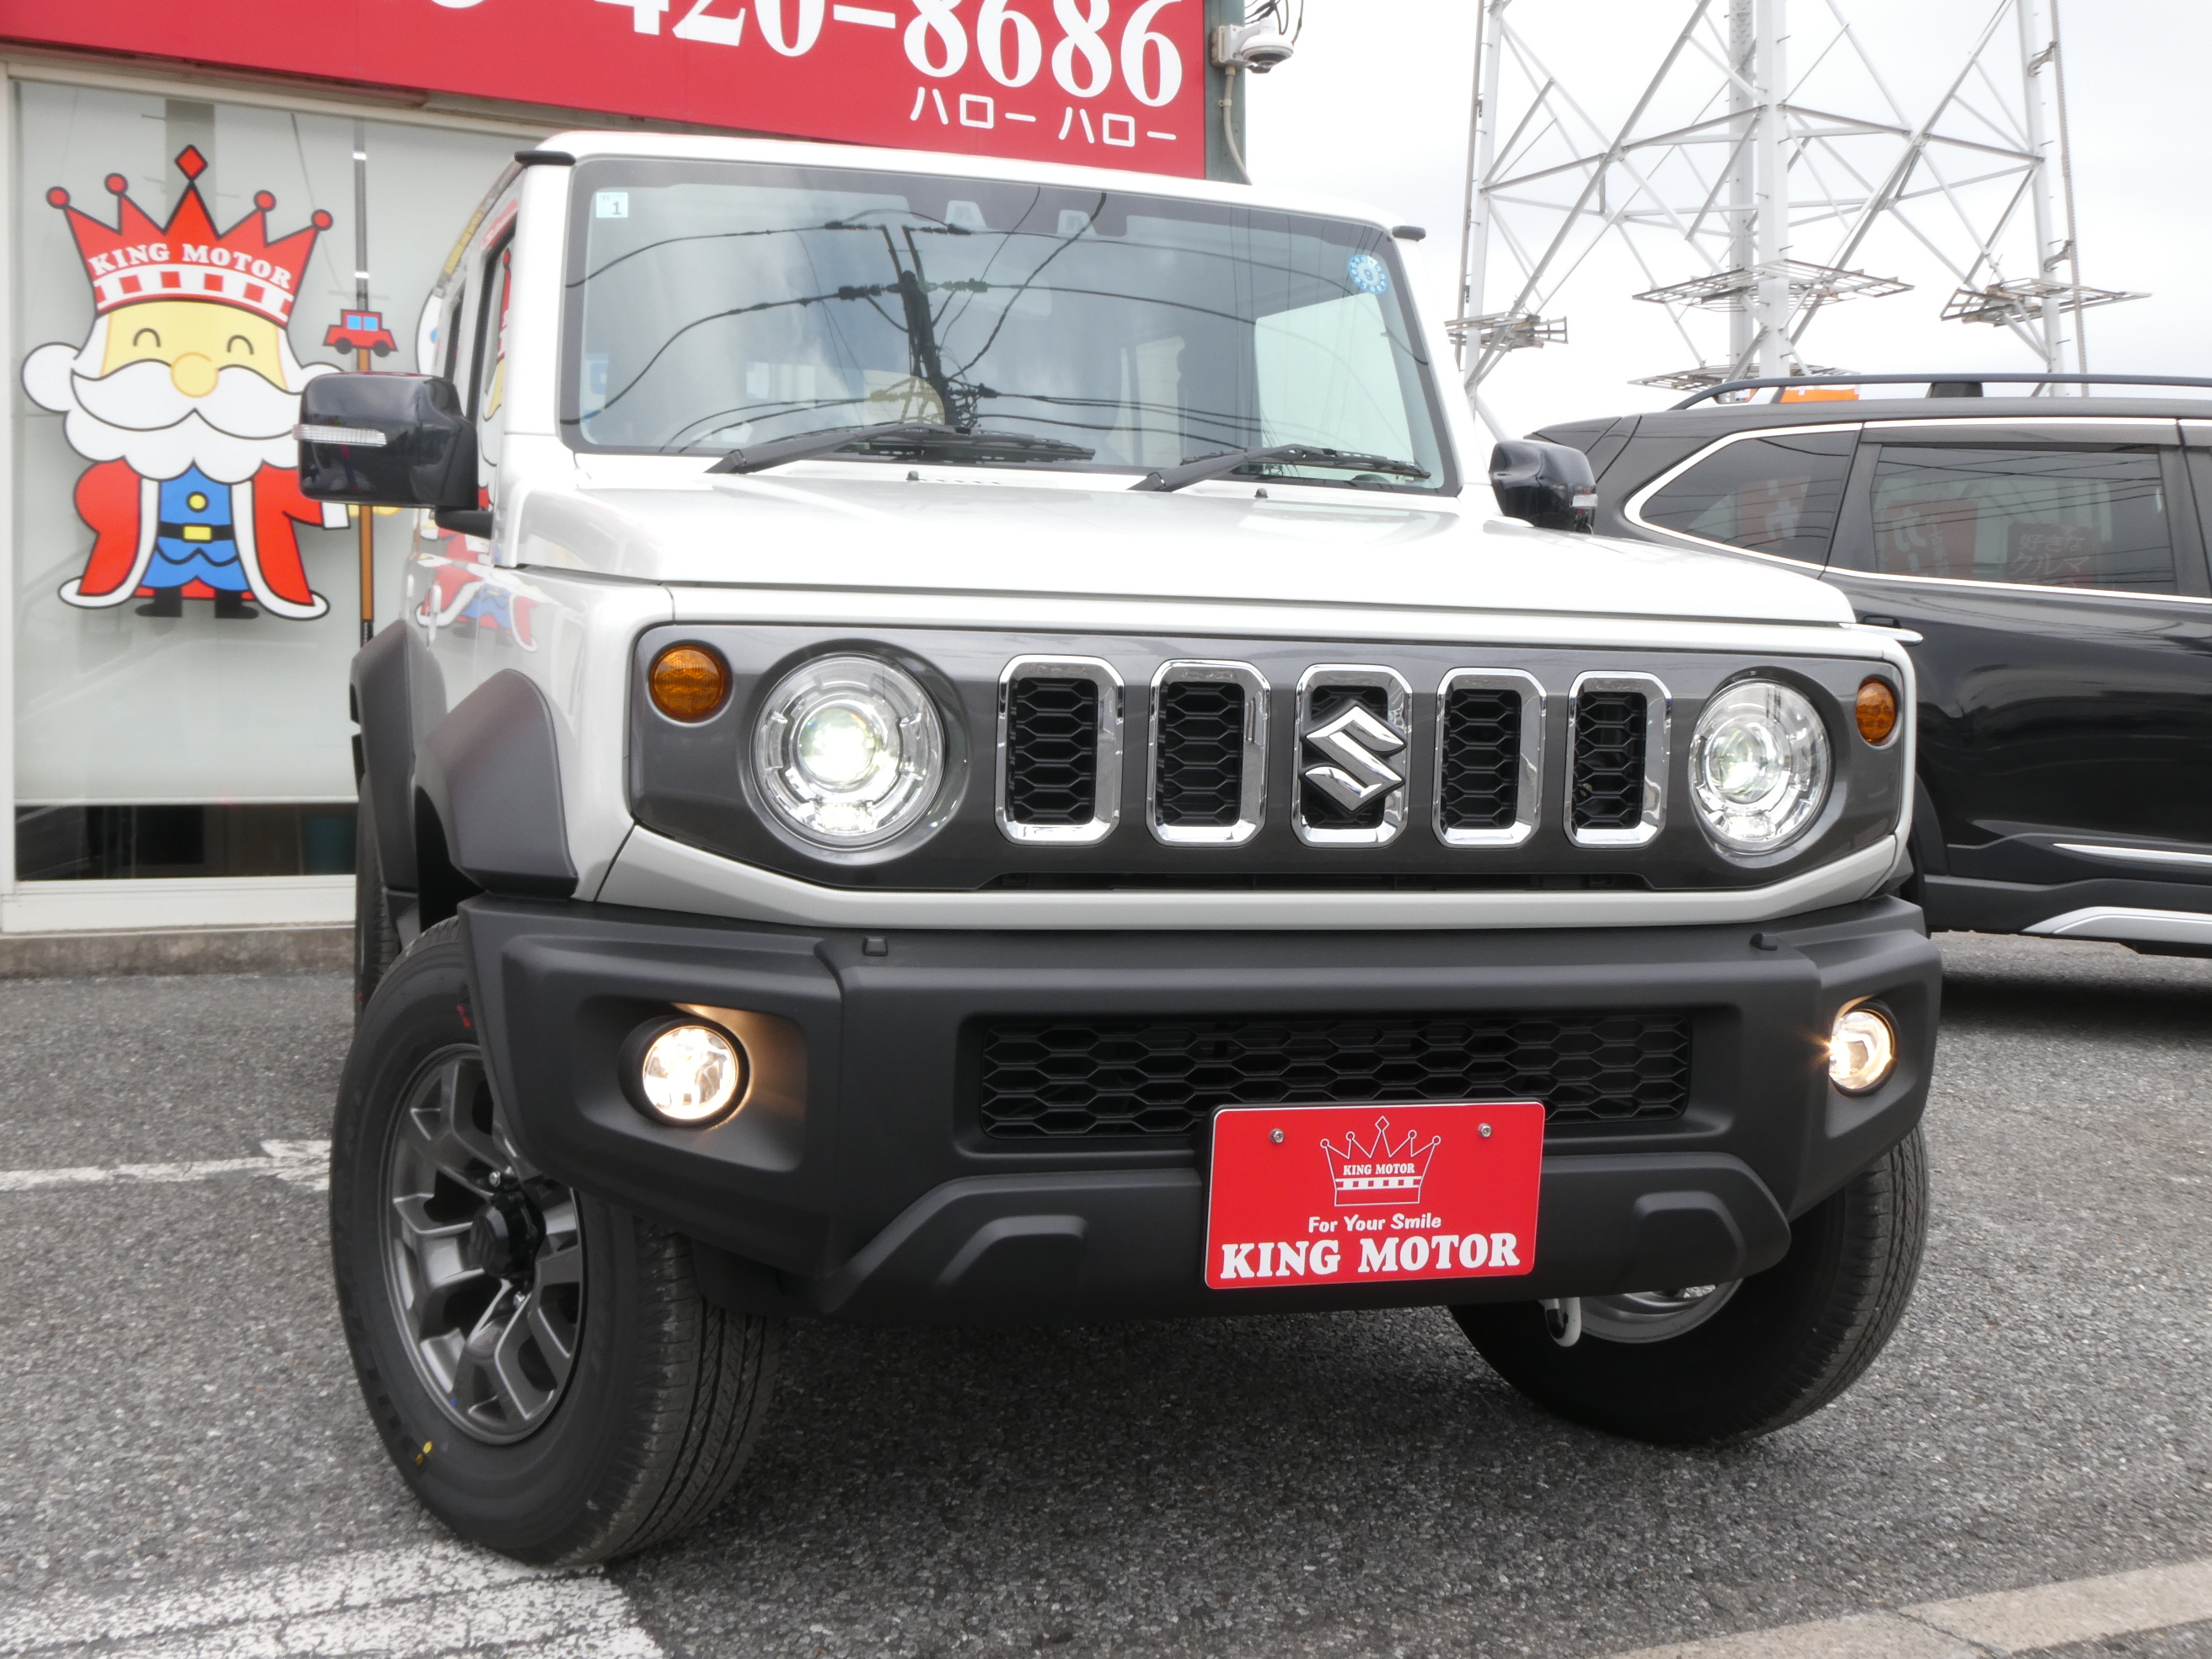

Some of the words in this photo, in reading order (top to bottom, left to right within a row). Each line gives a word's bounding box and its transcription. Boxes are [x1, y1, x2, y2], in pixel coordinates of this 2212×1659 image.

[595, 0, 1182, 107] -8686
[910, 87, 1036, 129] ハロー
[1058, 106, 1177, 147] ハロー
[612, 201, 621, 215] 1
[89, 243, 170, 276] KING
[182, 244, 292, 289] MOTOR
[2010, 552, 2091, 576] クルマ
[1343, 1164, 1372, 1176] KING
[1376, 1162, 1415, 1174] MOTOR
[1308, 1216, 1338, 1233] For
[1344, 1214, 1385, 1232] Your
[1390, 1212, 1442, 1229] Smile
[1220, 1239, 1341, 1279] KING
[1357, 1232, 1520, 1273] MOTOR
